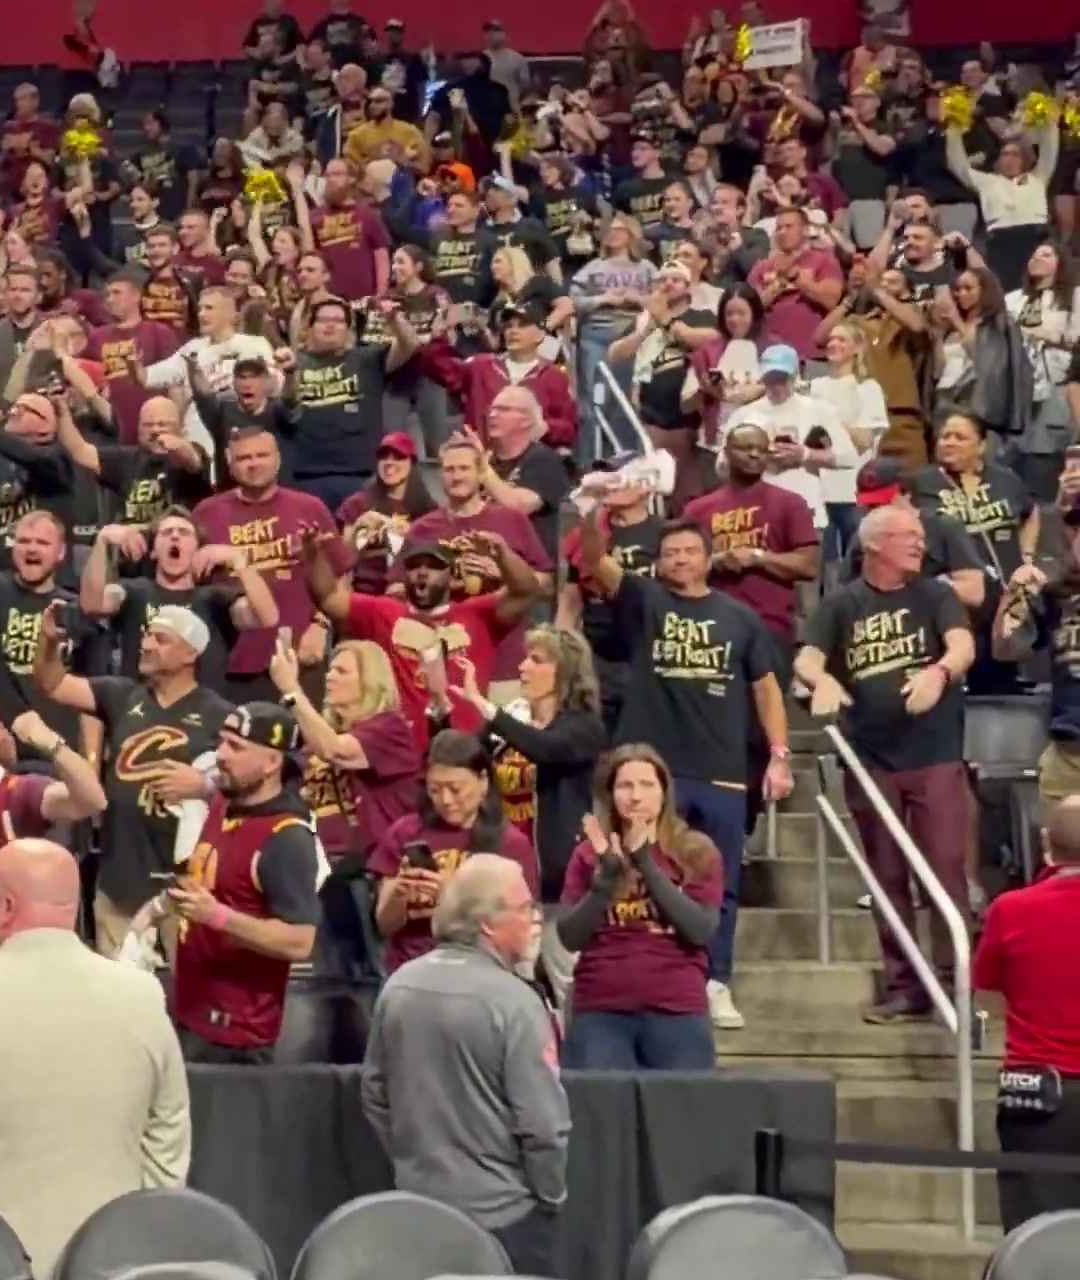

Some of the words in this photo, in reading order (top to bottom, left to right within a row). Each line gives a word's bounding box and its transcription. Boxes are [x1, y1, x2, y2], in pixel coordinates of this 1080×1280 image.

[711, 506, 762, 534] BEAT
[663, 610, 717, 645] BEAT
[853, 607, 911, 645] BEAT
[651, 639, 733, 669] DETROIT!
[846, 626, 926, 671] DETROIT!
